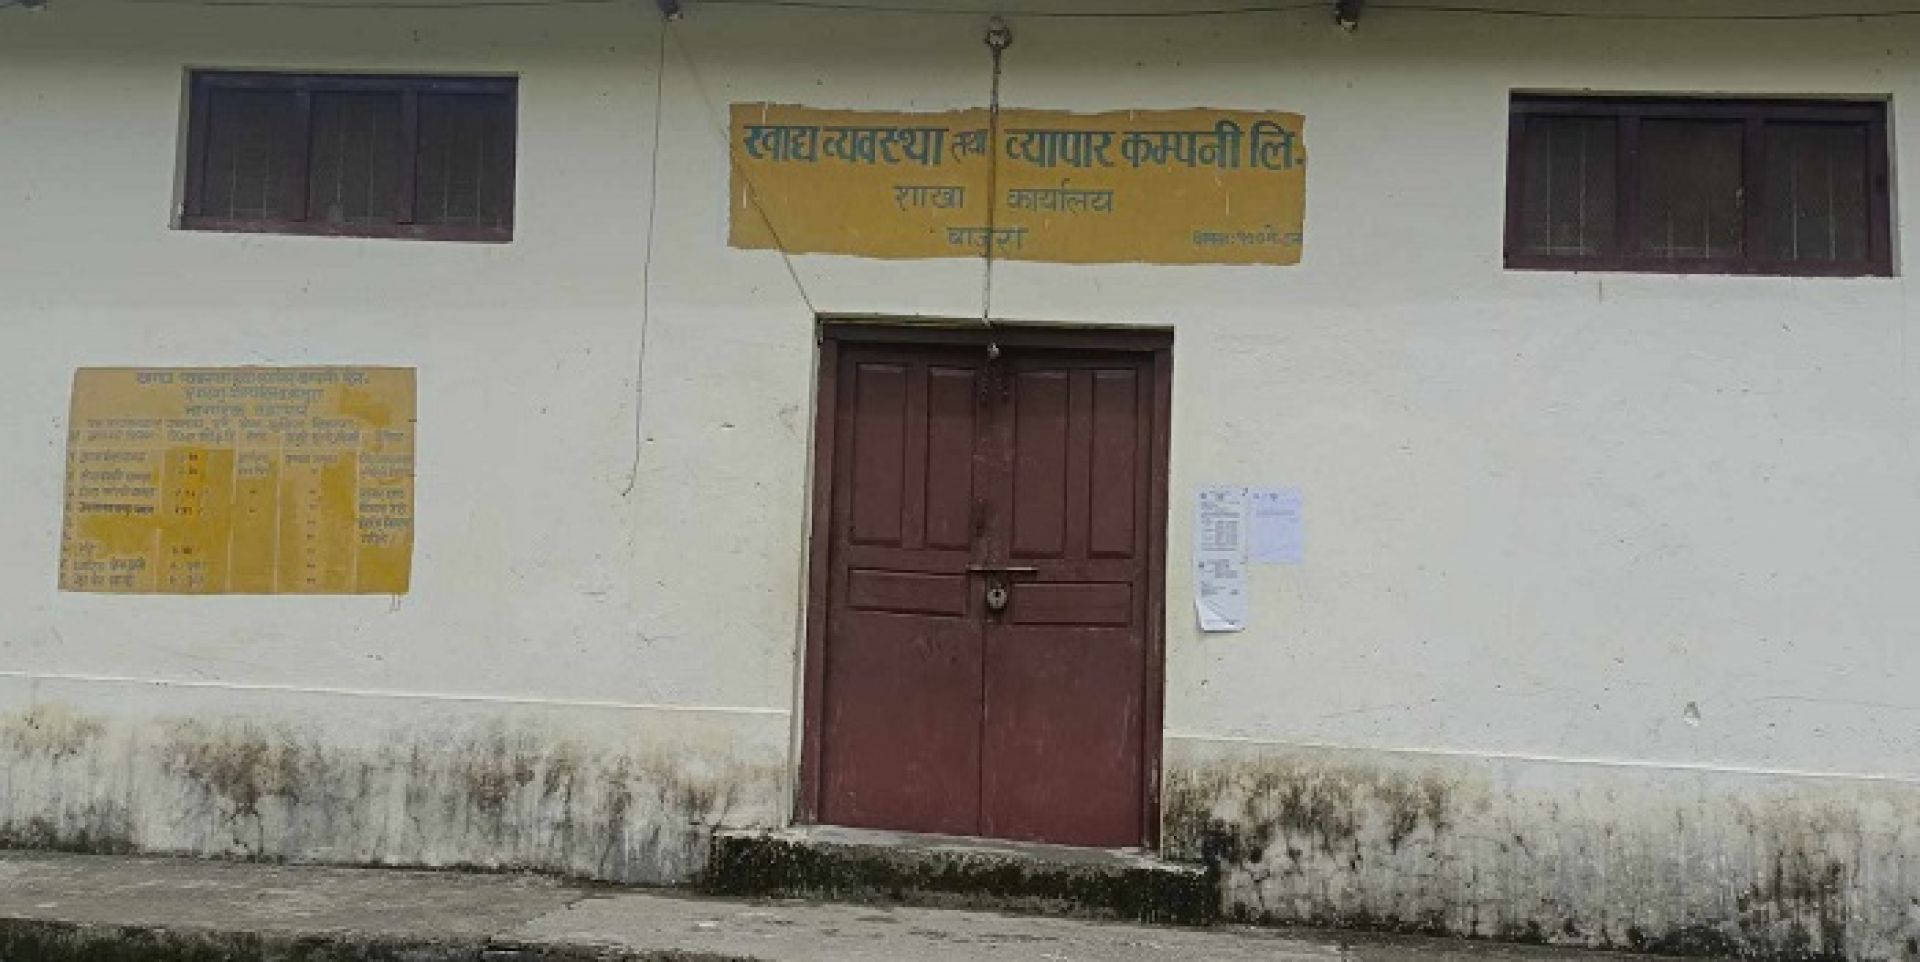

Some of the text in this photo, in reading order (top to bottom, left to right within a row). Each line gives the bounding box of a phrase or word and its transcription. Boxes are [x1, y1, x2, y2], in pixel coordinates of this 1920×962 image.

[743, 126, 820, 162] खाद्य
[822, 126, 949, 165] व्यवस्था
[1004, 128, 1116, 168] व्यापार
[1121, 120, 1246, 170] कम्पनी
[1250, 119, 1305, 171] लि.
[893, 178, 1114, 214] शाखा कार्यालय
